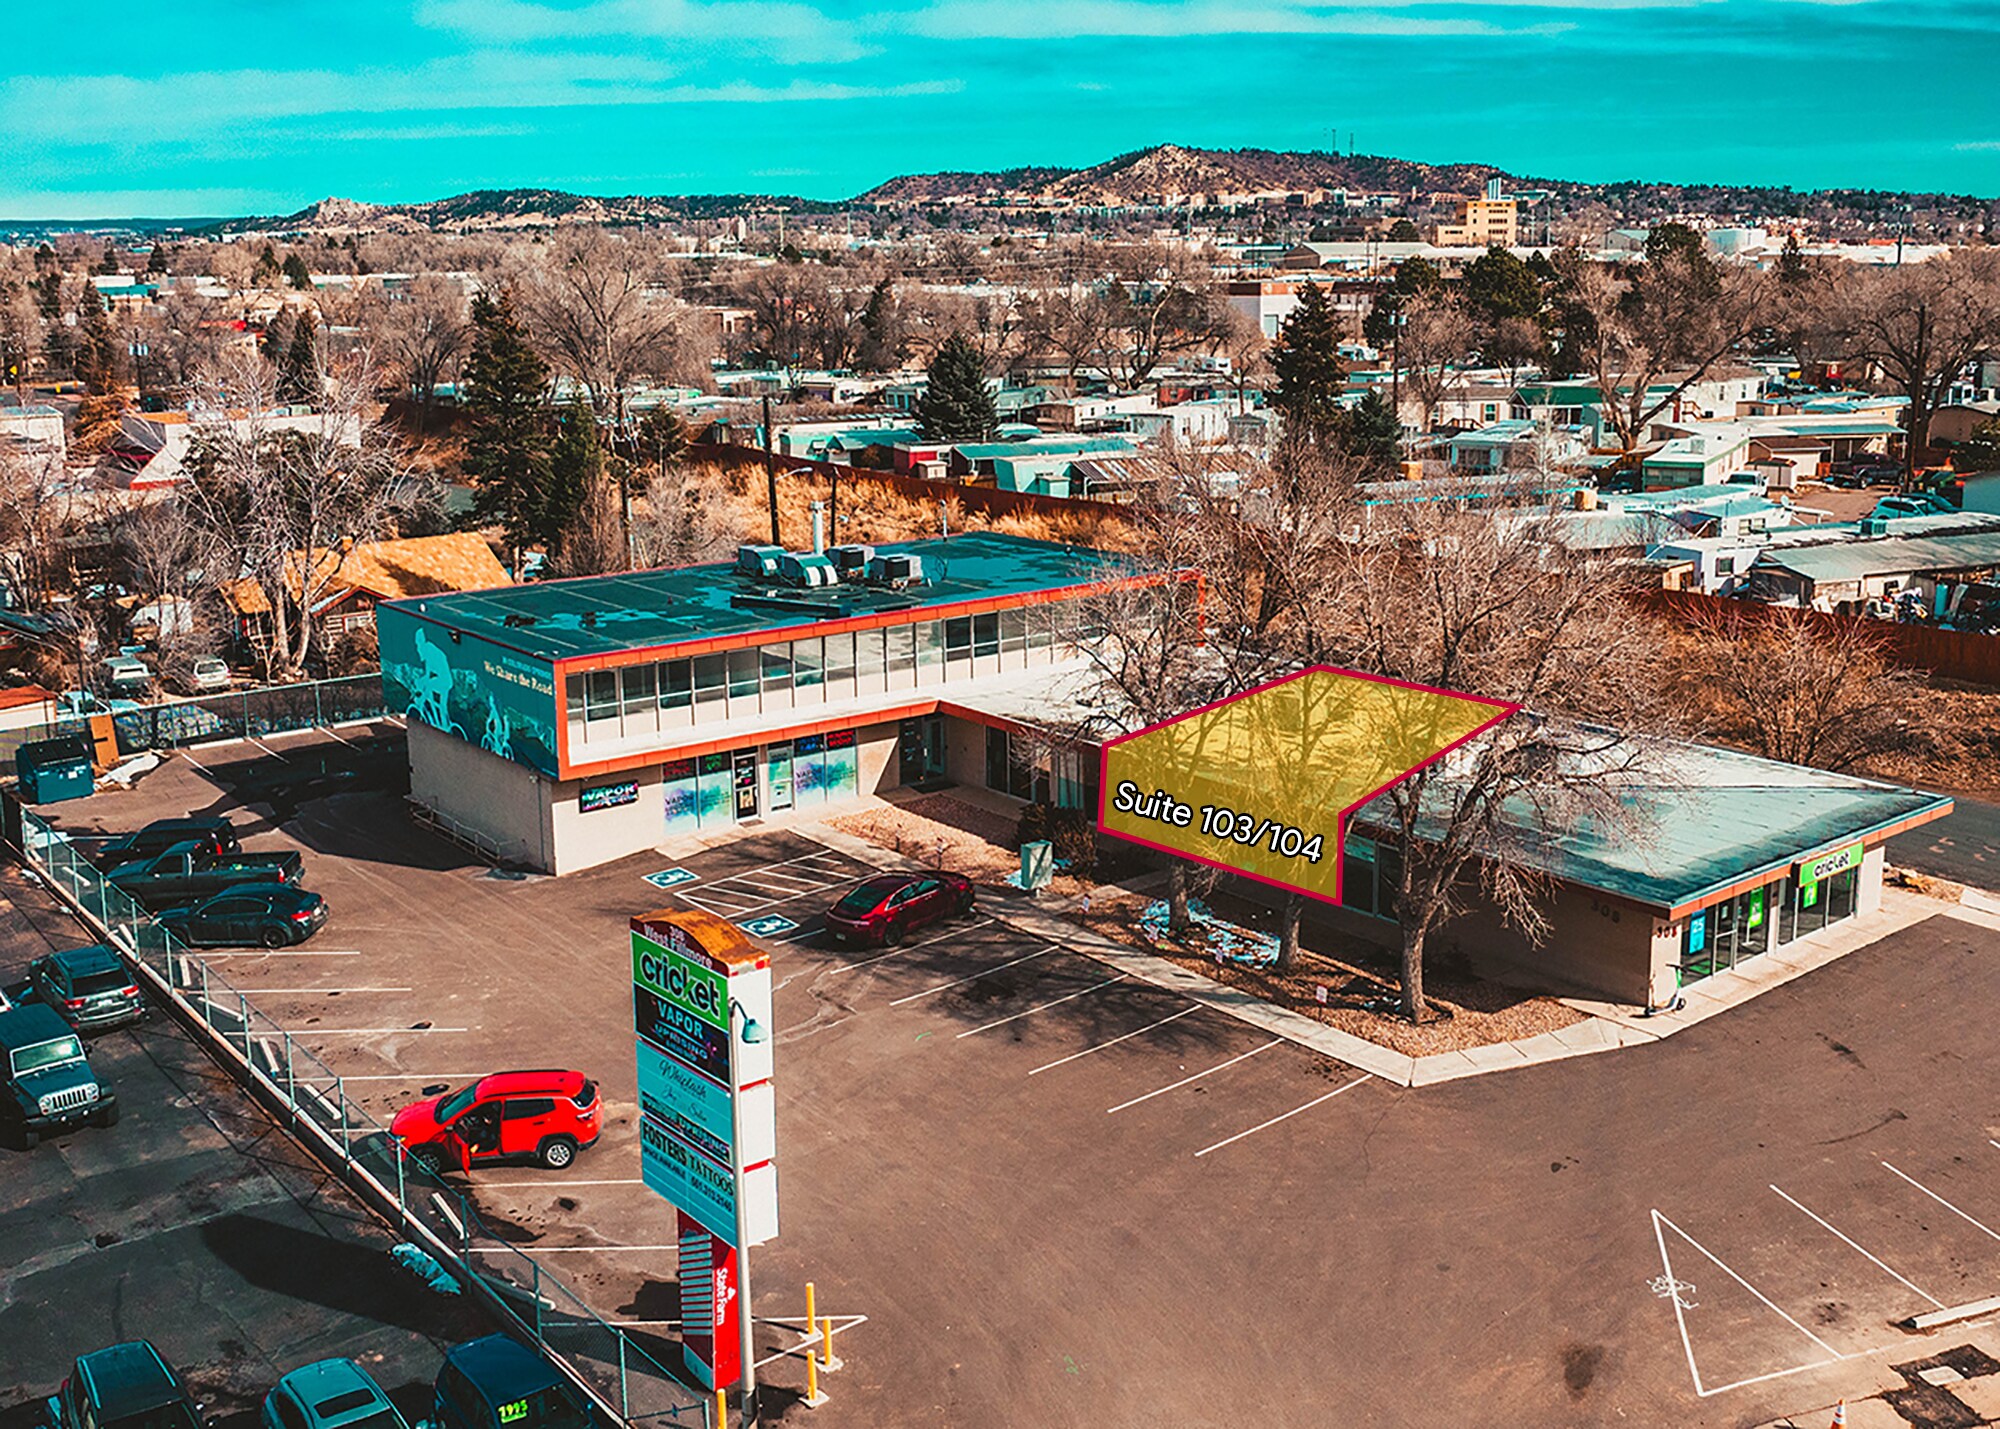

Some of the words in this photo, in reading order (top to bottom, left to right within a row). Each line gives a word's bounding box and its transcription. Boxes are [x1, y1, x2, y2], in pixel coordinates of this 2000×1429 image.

[1813, 850, 1850, 878] cricket
[643, 923, 669, 948] West
[669, 937, 713, 969] Fillmore
[641, 952, 720, 1020] cricket
[657, 999, 704, 1040] VAPOR
[654, 1023, 708, 1060] UPRISING
[689, 1153, 735, 1197] TATTOOS
[716, 1267, 729, 1298] State
[716, 1298, 728, 1327] Farm
